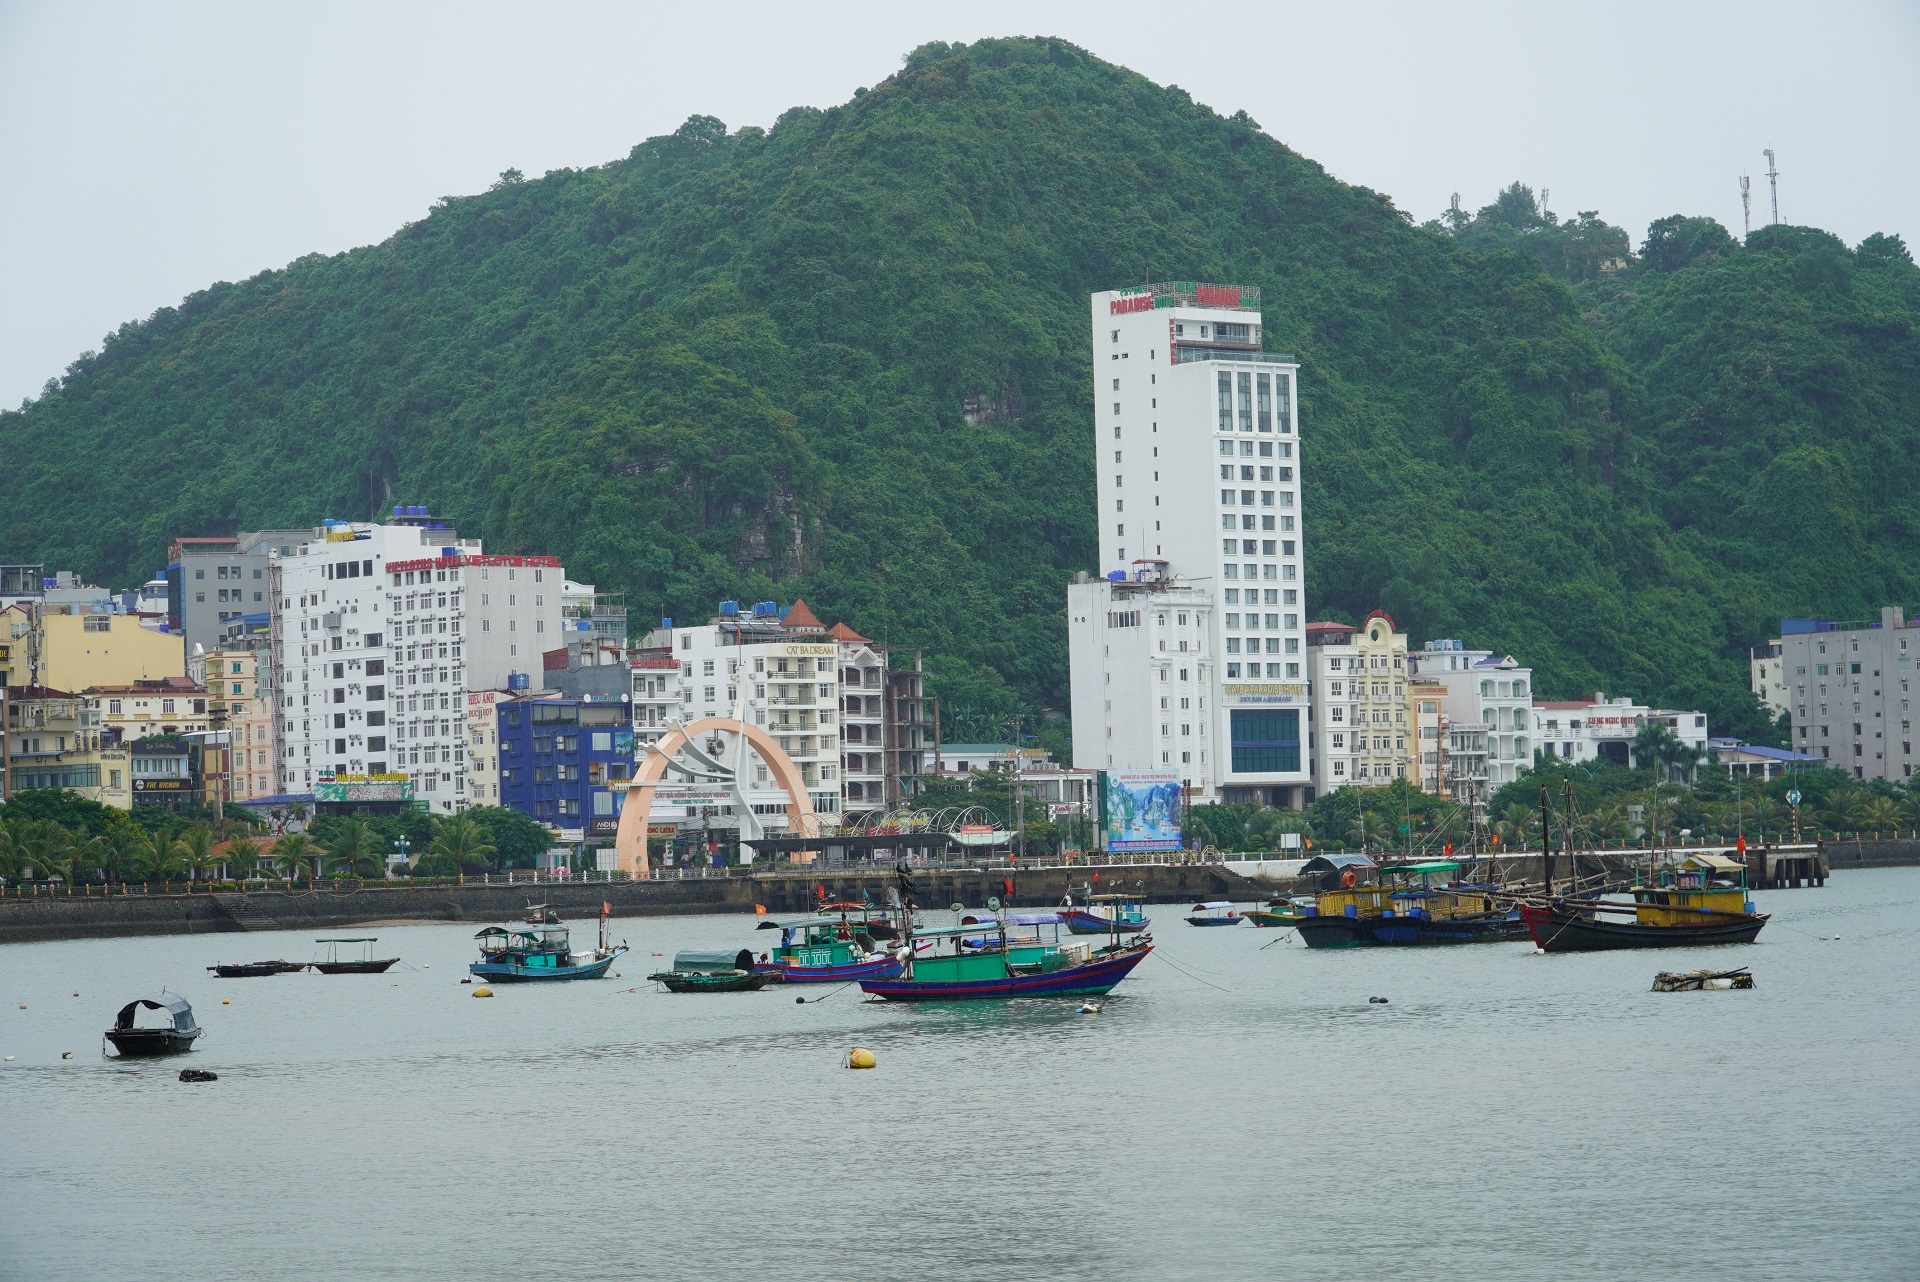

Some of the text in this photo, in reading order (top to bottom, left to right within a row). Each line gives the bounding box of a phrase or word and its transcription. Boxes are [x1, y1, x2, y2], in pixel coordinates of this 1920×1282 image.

[1197, 287, 1240, 307] PARADISE
[1110, 295, 1154, 316] PARADISE
[386, 555, 463, 573] VIETLOTUS HOTEL
[464, 555, 562, 567] VIETLOTUS HOTEL
[810, 645, 834, 654] DREAM
[1226, 684, 1304, 694] CATBA PARADISE HOTEL
[1605, 716, 1620, 725] NGOC
[1620, 716, 1637, 725] HOTEL
[146, 781, 157, 789] THE
[1791, 793, 1797, 801] P
